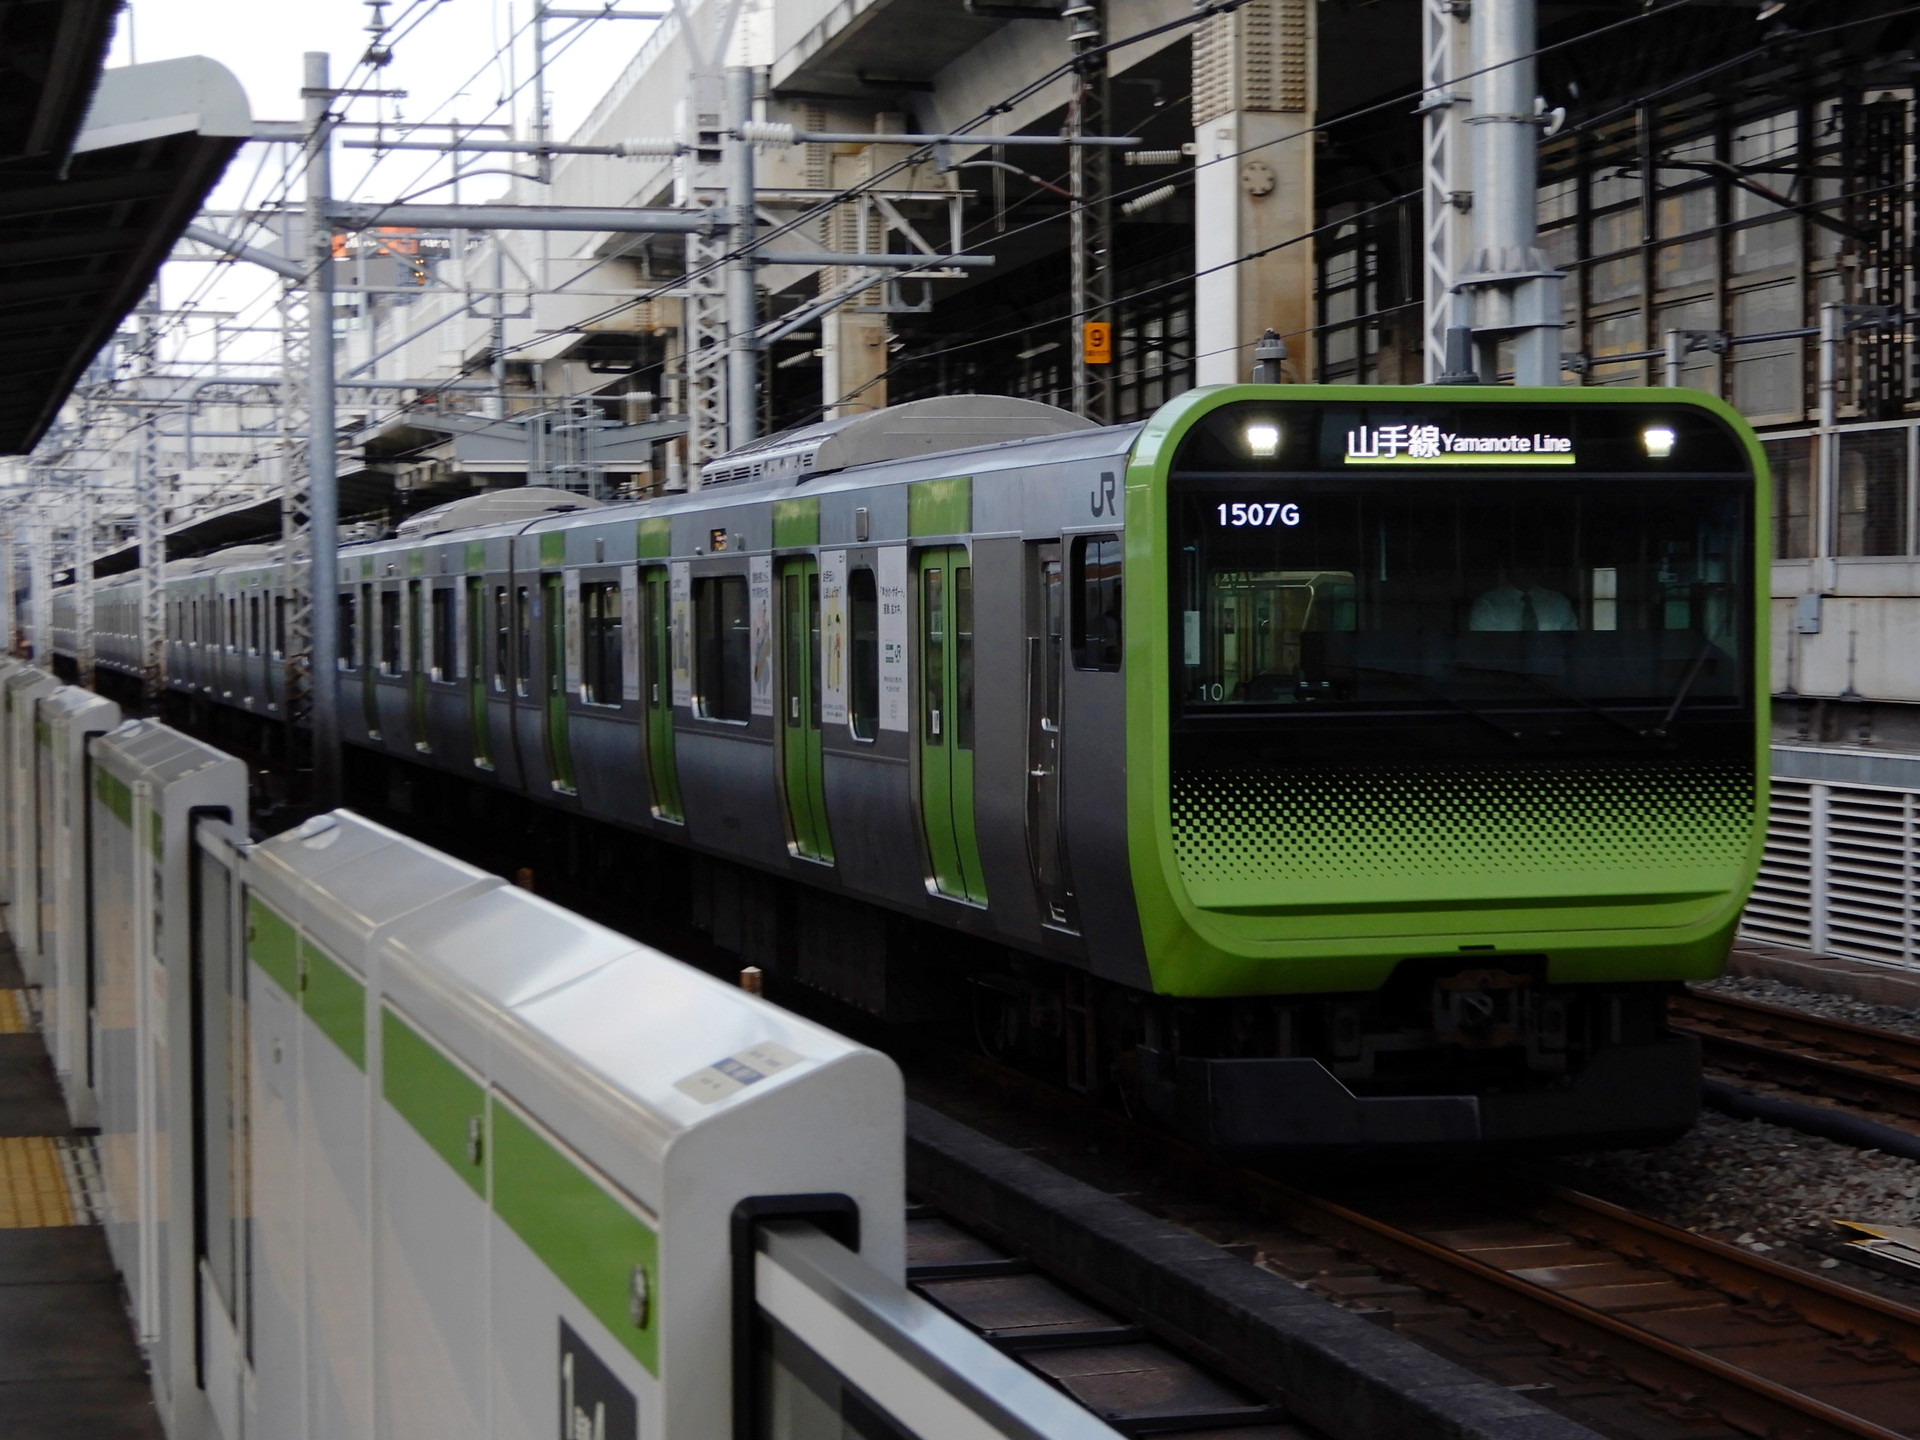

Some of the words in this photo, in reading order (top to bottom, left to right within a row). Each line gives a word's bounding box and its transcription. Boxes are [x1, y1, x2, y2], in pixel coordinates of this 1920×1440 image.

[1090, 329, 1105, 347] 9
[1348, 425, 1441, 458] 山手線
[1441, 433, 1530, 453] Yamanote
[1533, 433, 1573, 452] Line
[1091, 471, 1115, 518] JR
[1217, 503, 1300, 526] 1507G
[1199, 683, 1223, 701] 10
